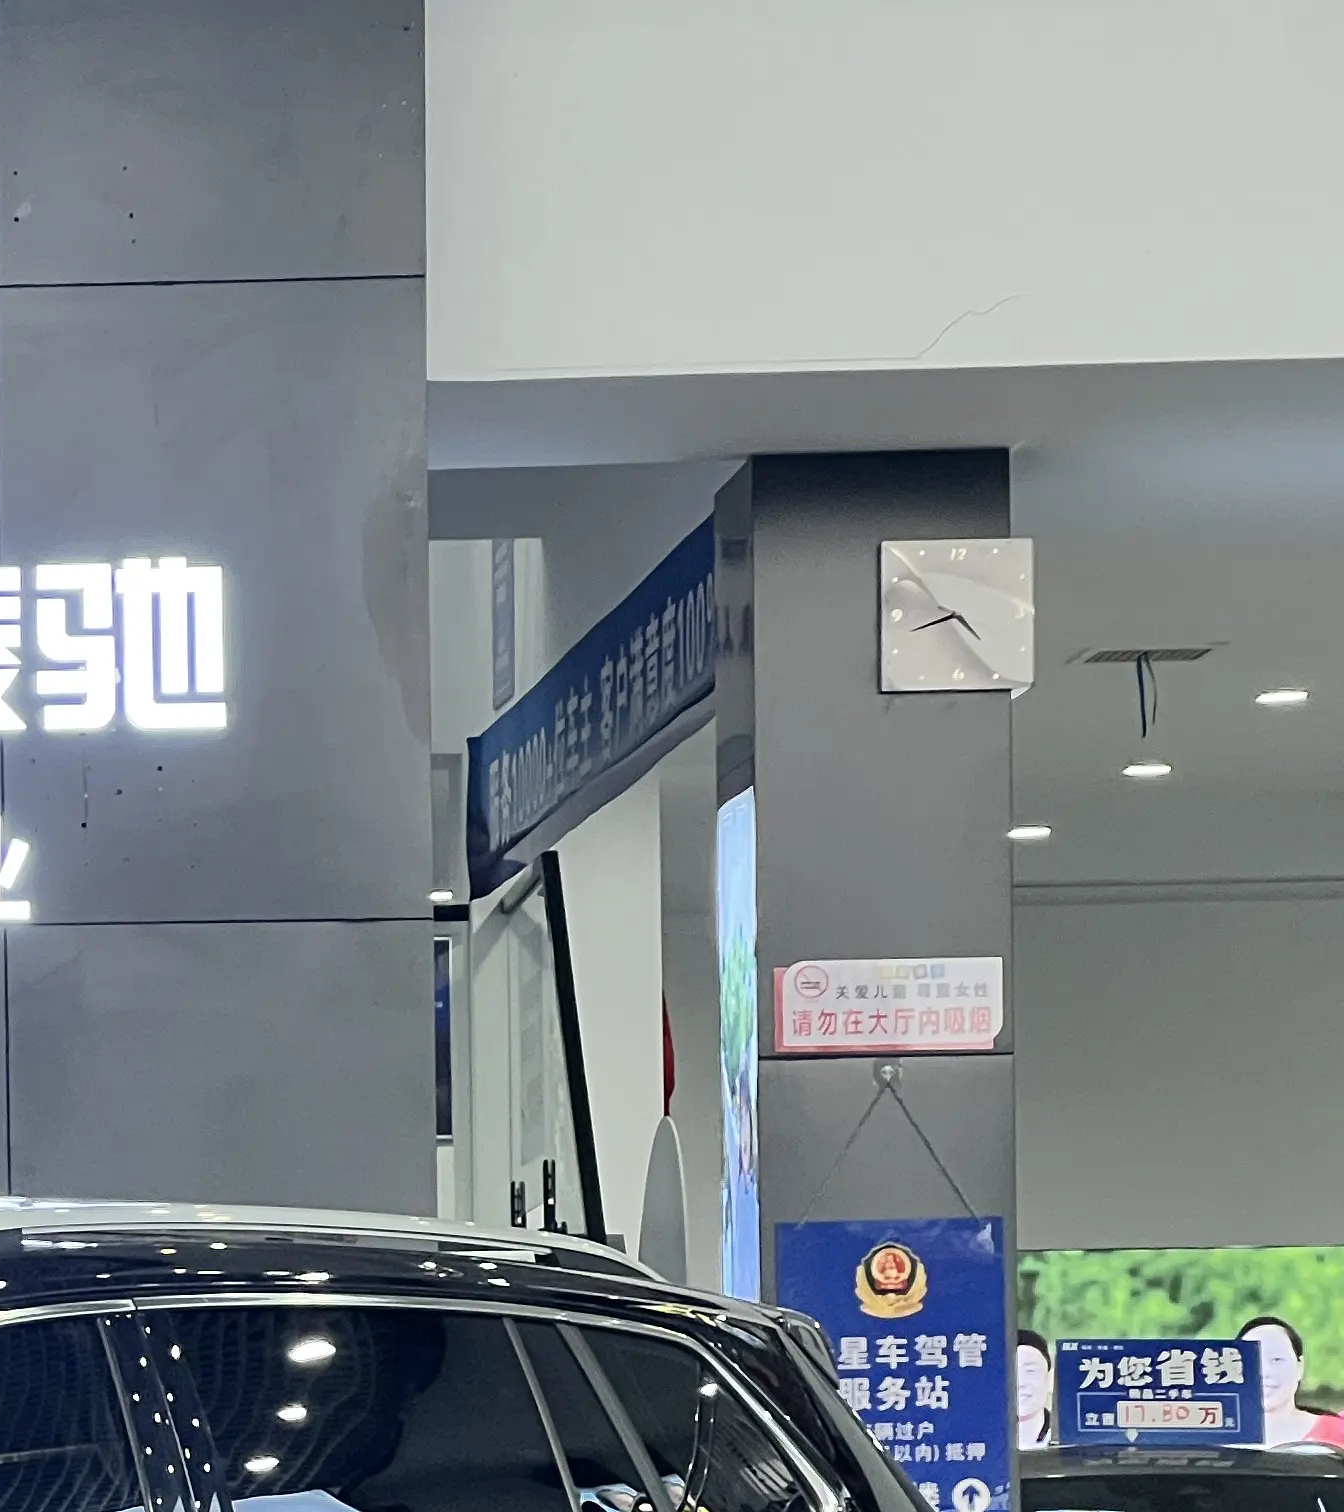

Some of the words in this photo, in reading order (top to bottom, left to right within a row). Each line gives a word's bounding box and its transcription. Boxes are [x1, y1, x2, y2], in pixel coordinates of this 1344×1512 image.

[792, 1006, 993, 1037] 请勿在大厅内吸烟
[1079, 1347, 1244, 1389] 为您省钱
[839, 1375, 950, 1411] 服务站
[867, 1421, 934, 1441] 辆过户
[1198, 1407, 1218, 1424] 万
